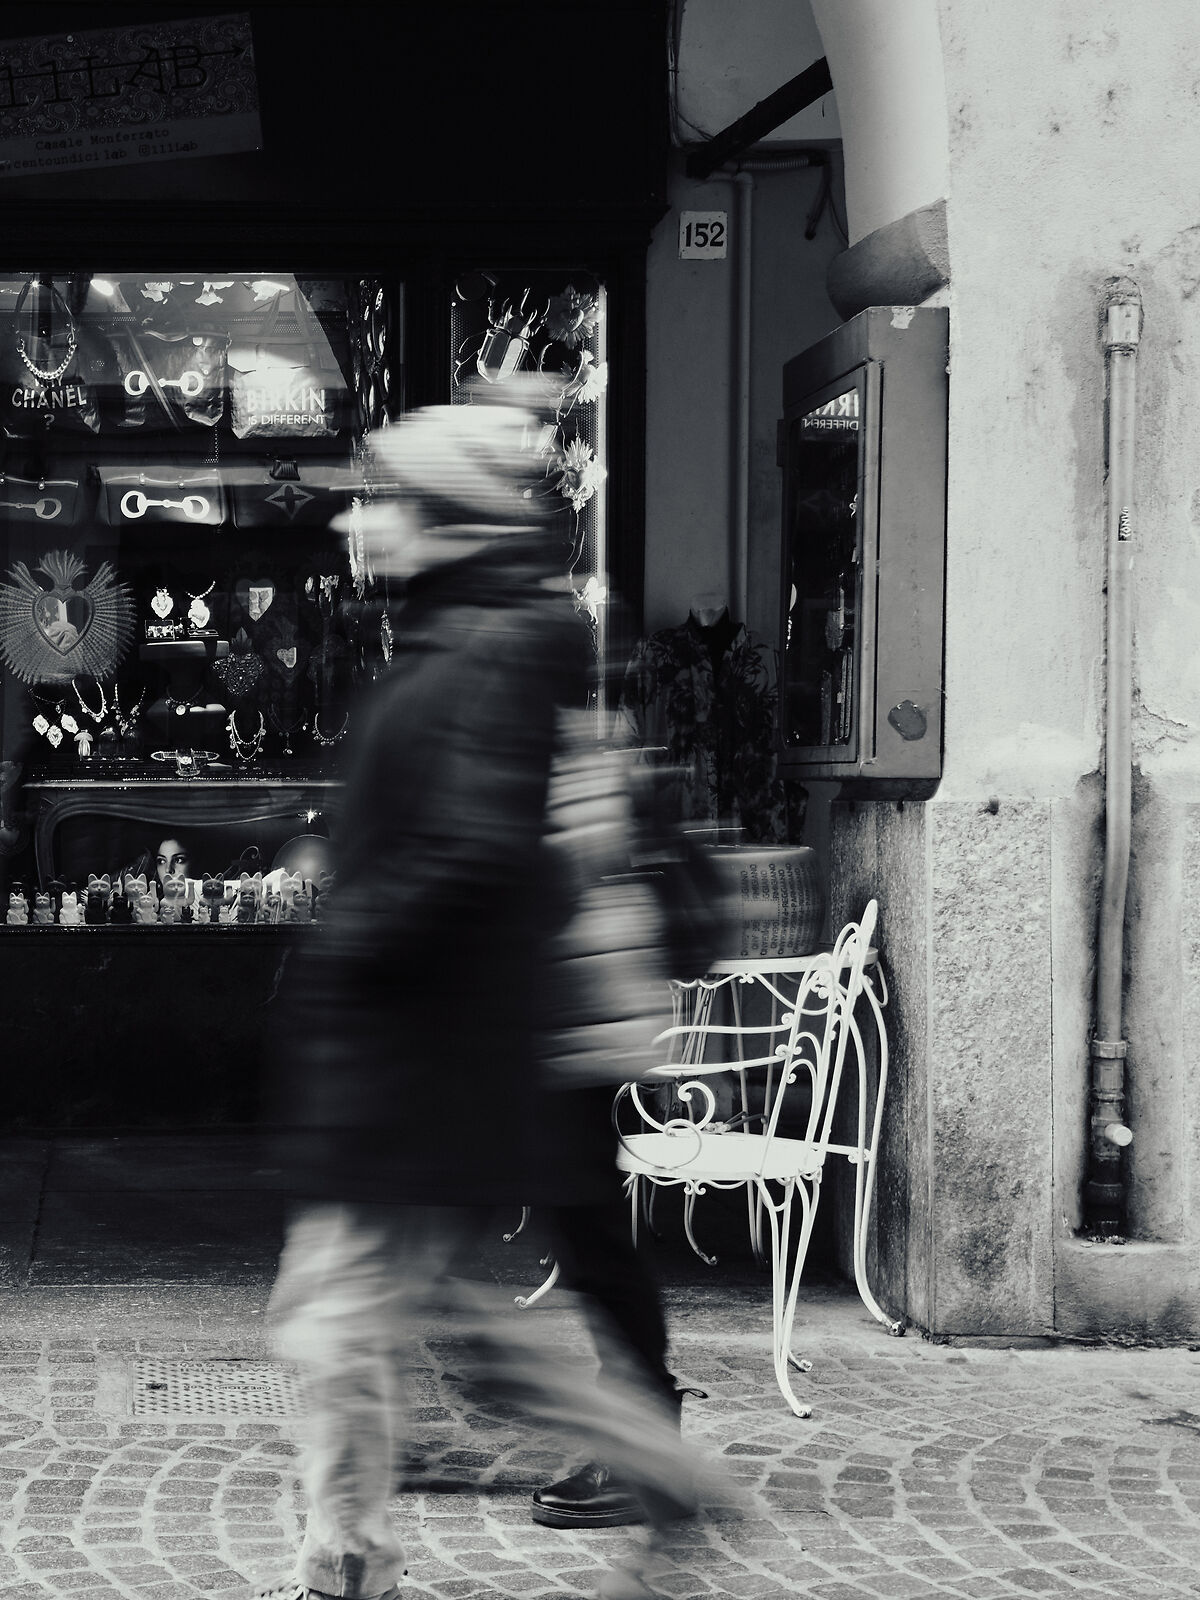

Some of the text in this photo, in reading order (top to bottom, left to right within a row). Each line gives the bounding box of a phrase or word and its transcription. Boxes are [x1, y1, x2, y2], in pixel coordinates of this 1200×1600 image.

[685, 221, 724, 248] 152
[246, 387, 325, 412] BIRKIN
[43, 413, 55, 430] ?
[248, 414, 325, 426] IS DIFFERENT
